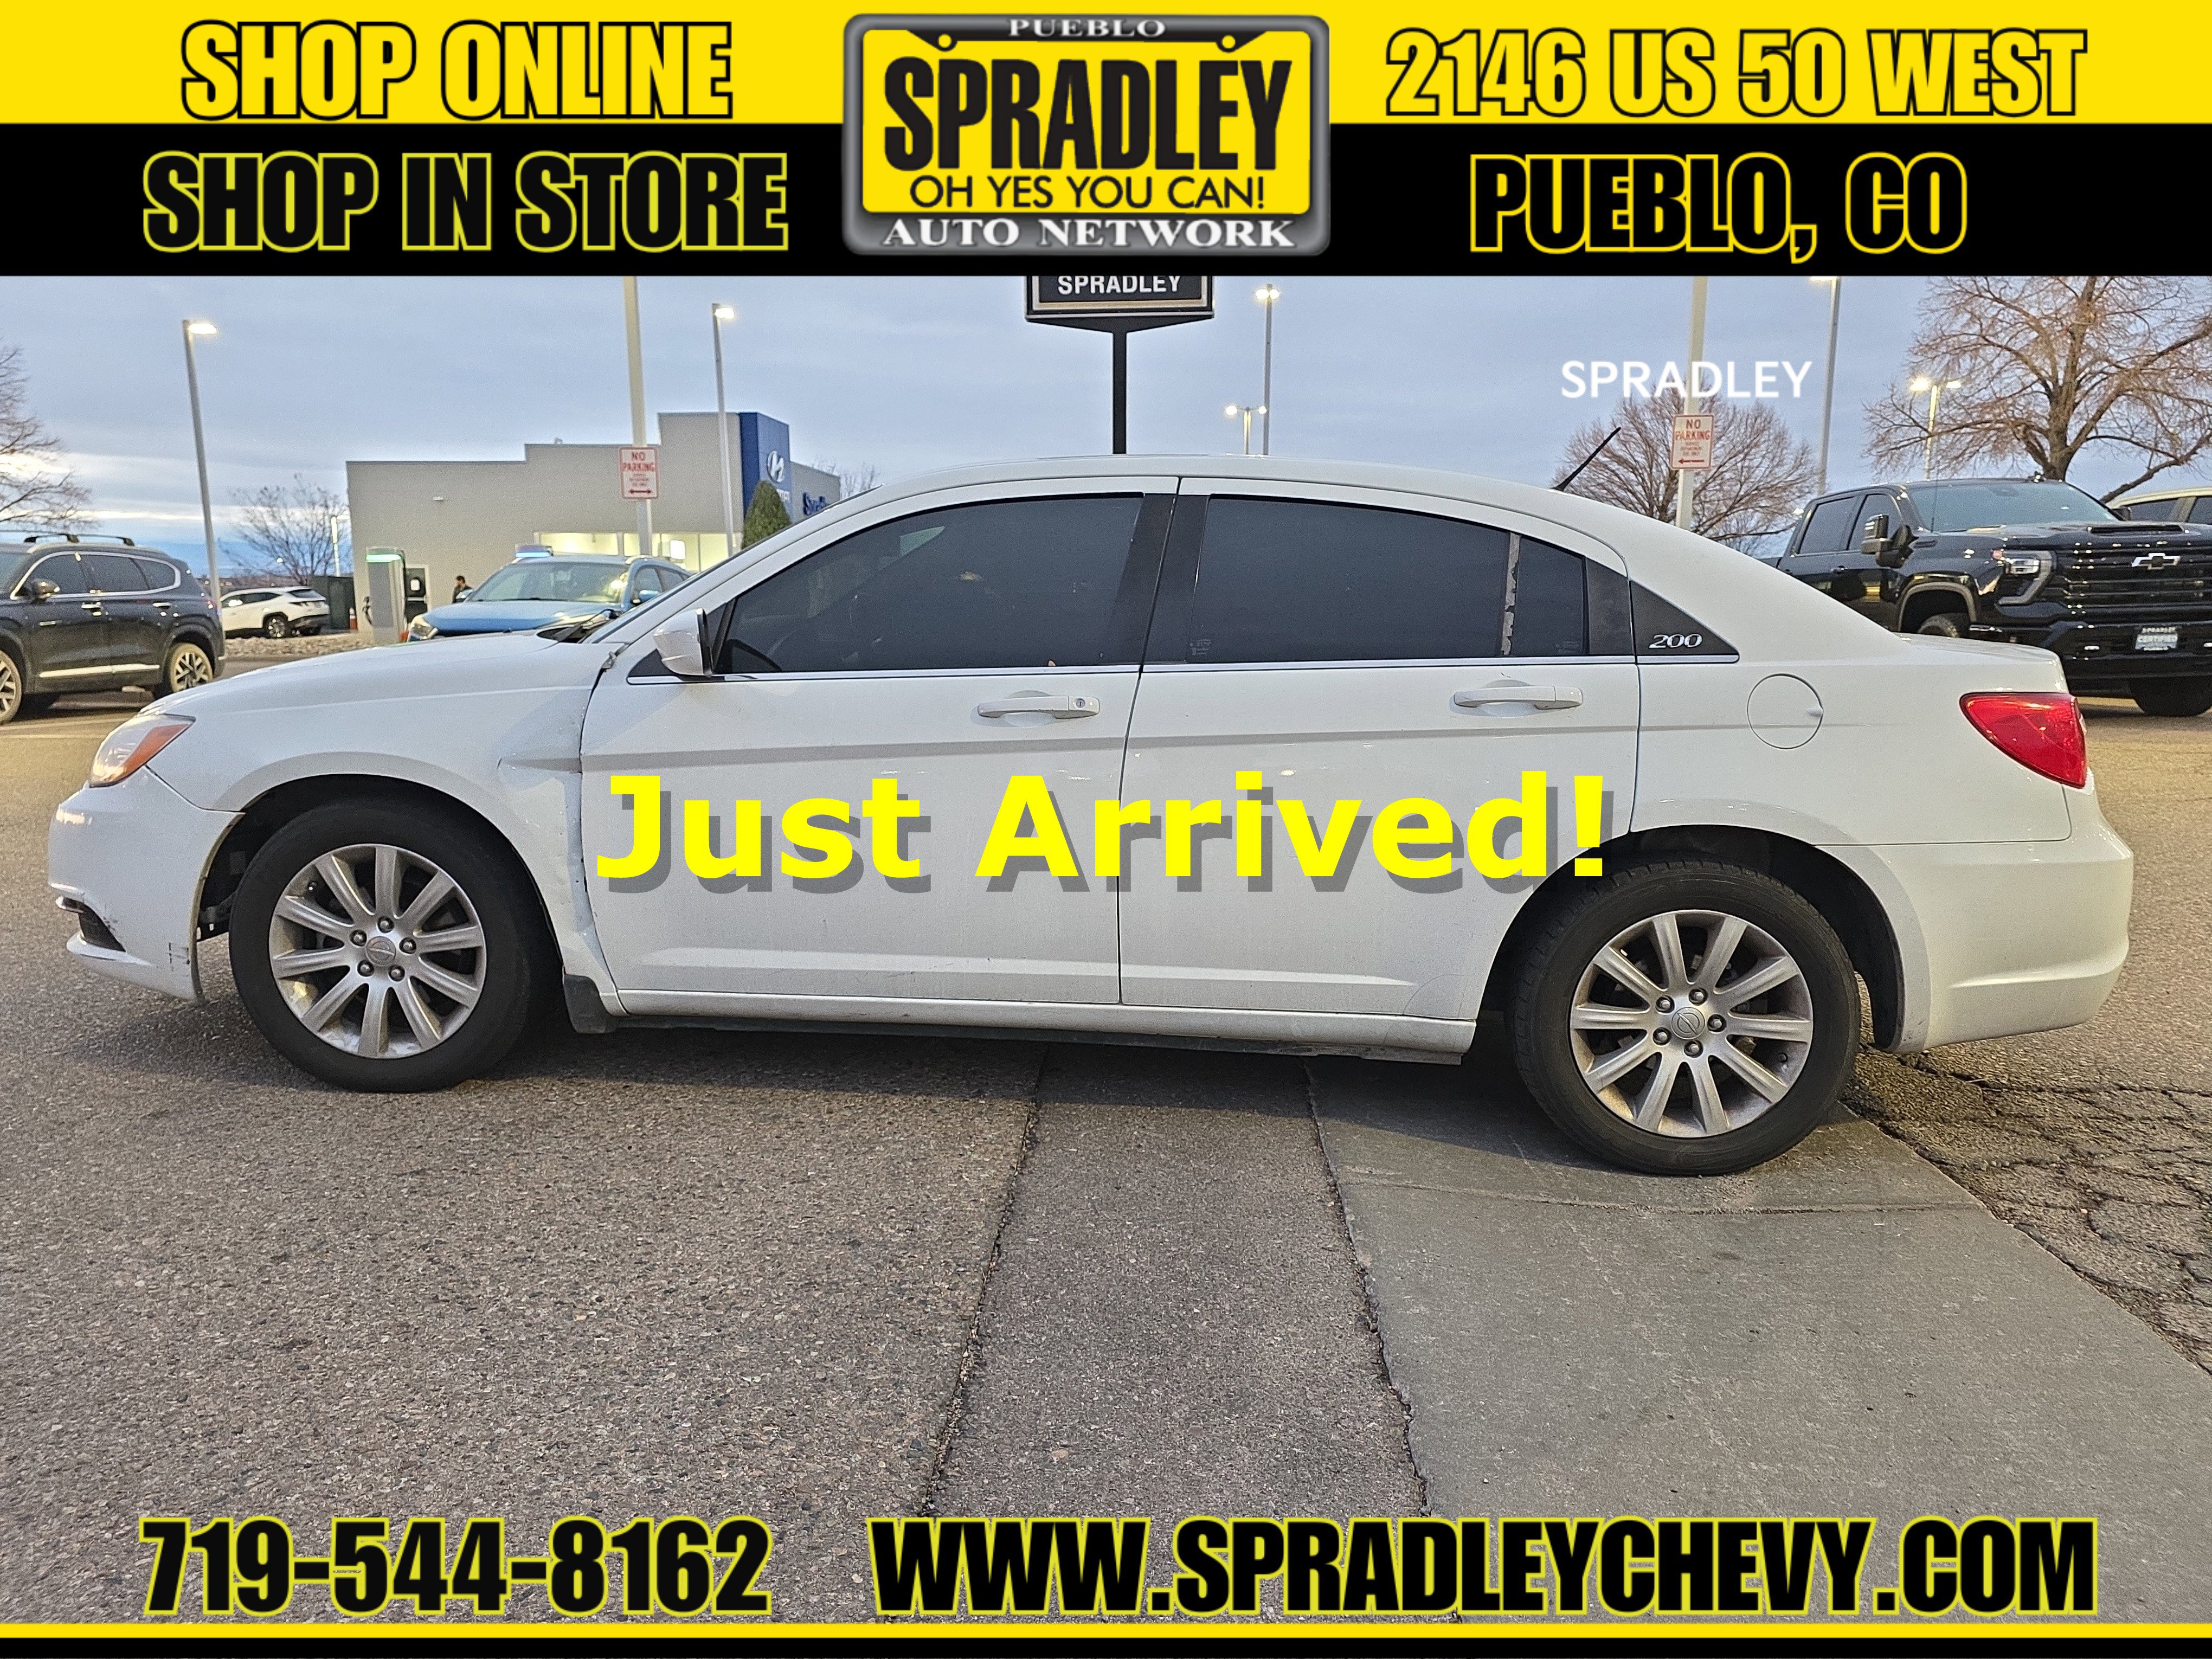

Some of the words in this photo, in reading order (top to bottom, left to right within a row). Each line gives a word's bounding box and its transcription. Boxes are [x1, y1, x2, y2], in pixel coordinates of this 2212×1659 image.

[1058, 276, 1181, 295] SPRADLEY
[1686, 419, 1701, 429] NO
[1675, 430, 1711, 440] PARKING
[632, 451, 646, 461] NO
[622, 462, 654, 471] PARKING
[1649, 634, 1702, 648] 200
